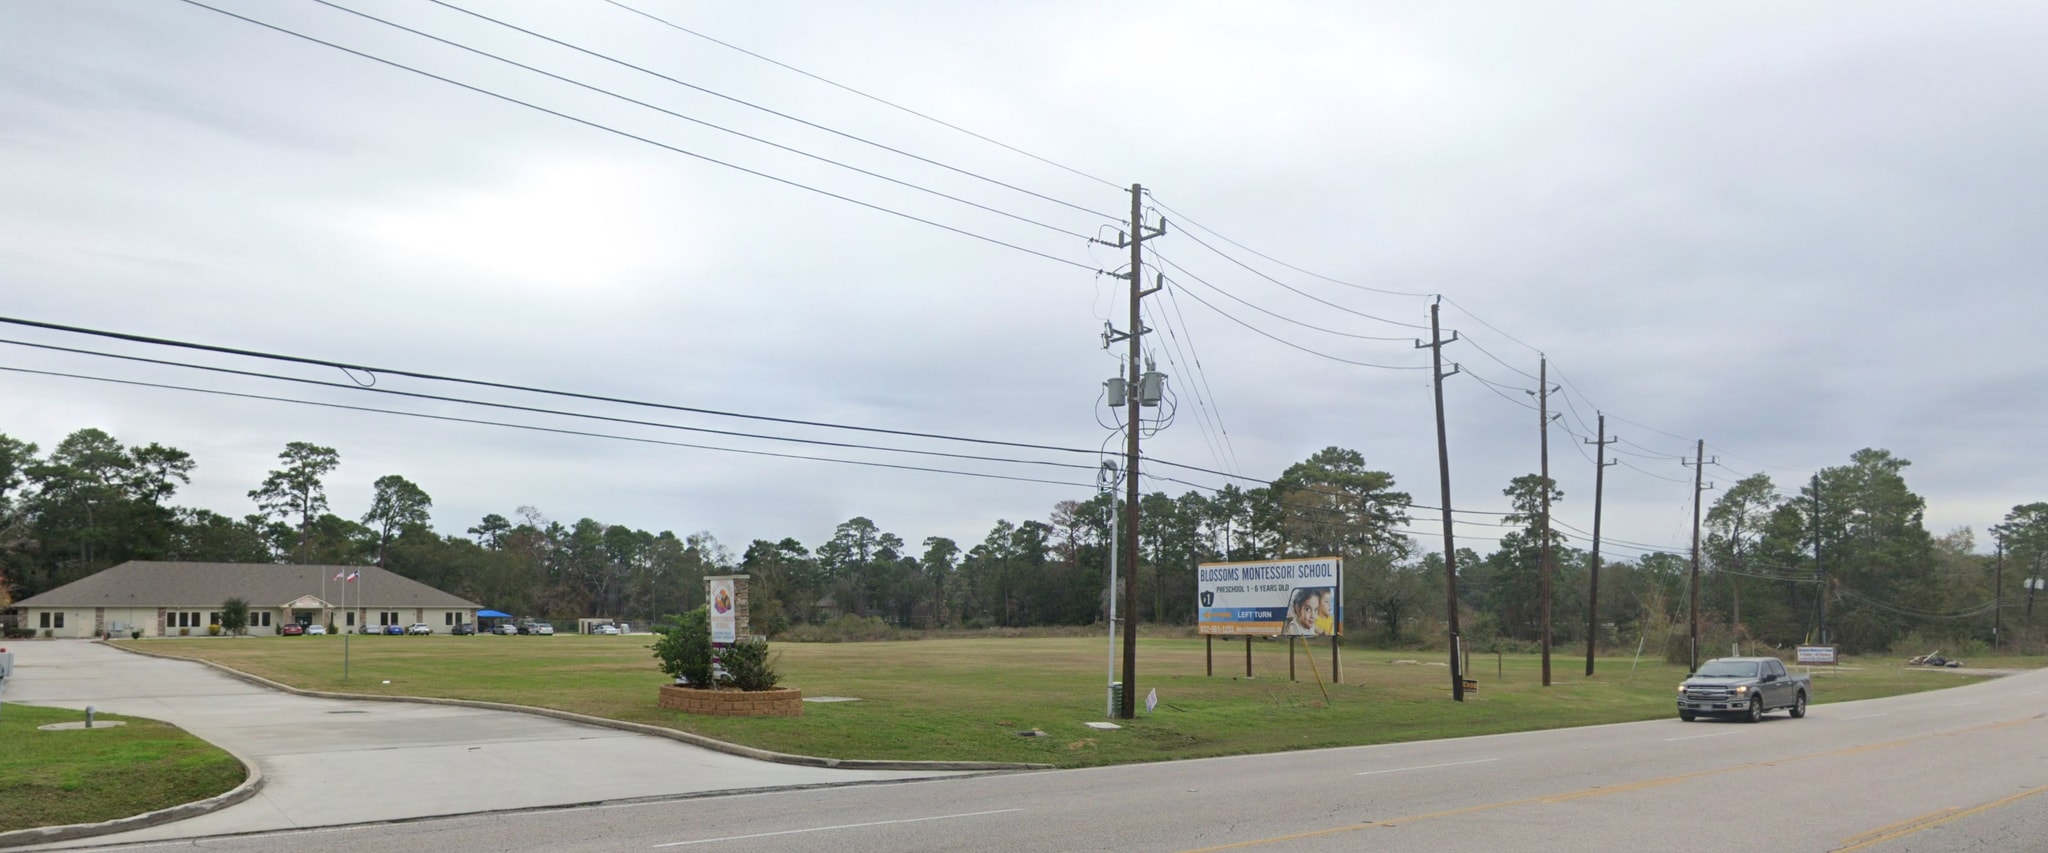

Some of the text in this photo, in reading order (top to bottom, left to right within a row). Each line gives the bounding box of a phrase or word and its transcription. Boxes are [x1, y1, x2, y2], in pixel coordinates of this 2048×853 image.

[1200, 563, 1332, 582] BLOSSOMS MONTESSORI SCHOOL
[1216, 585, 1245, 593] PRESCHOOL
[1260, 584, 1278, 592] YEARS
[1278, 583, 1290, 592] OLD
[1237, 611, 1253, 619] LEFT
